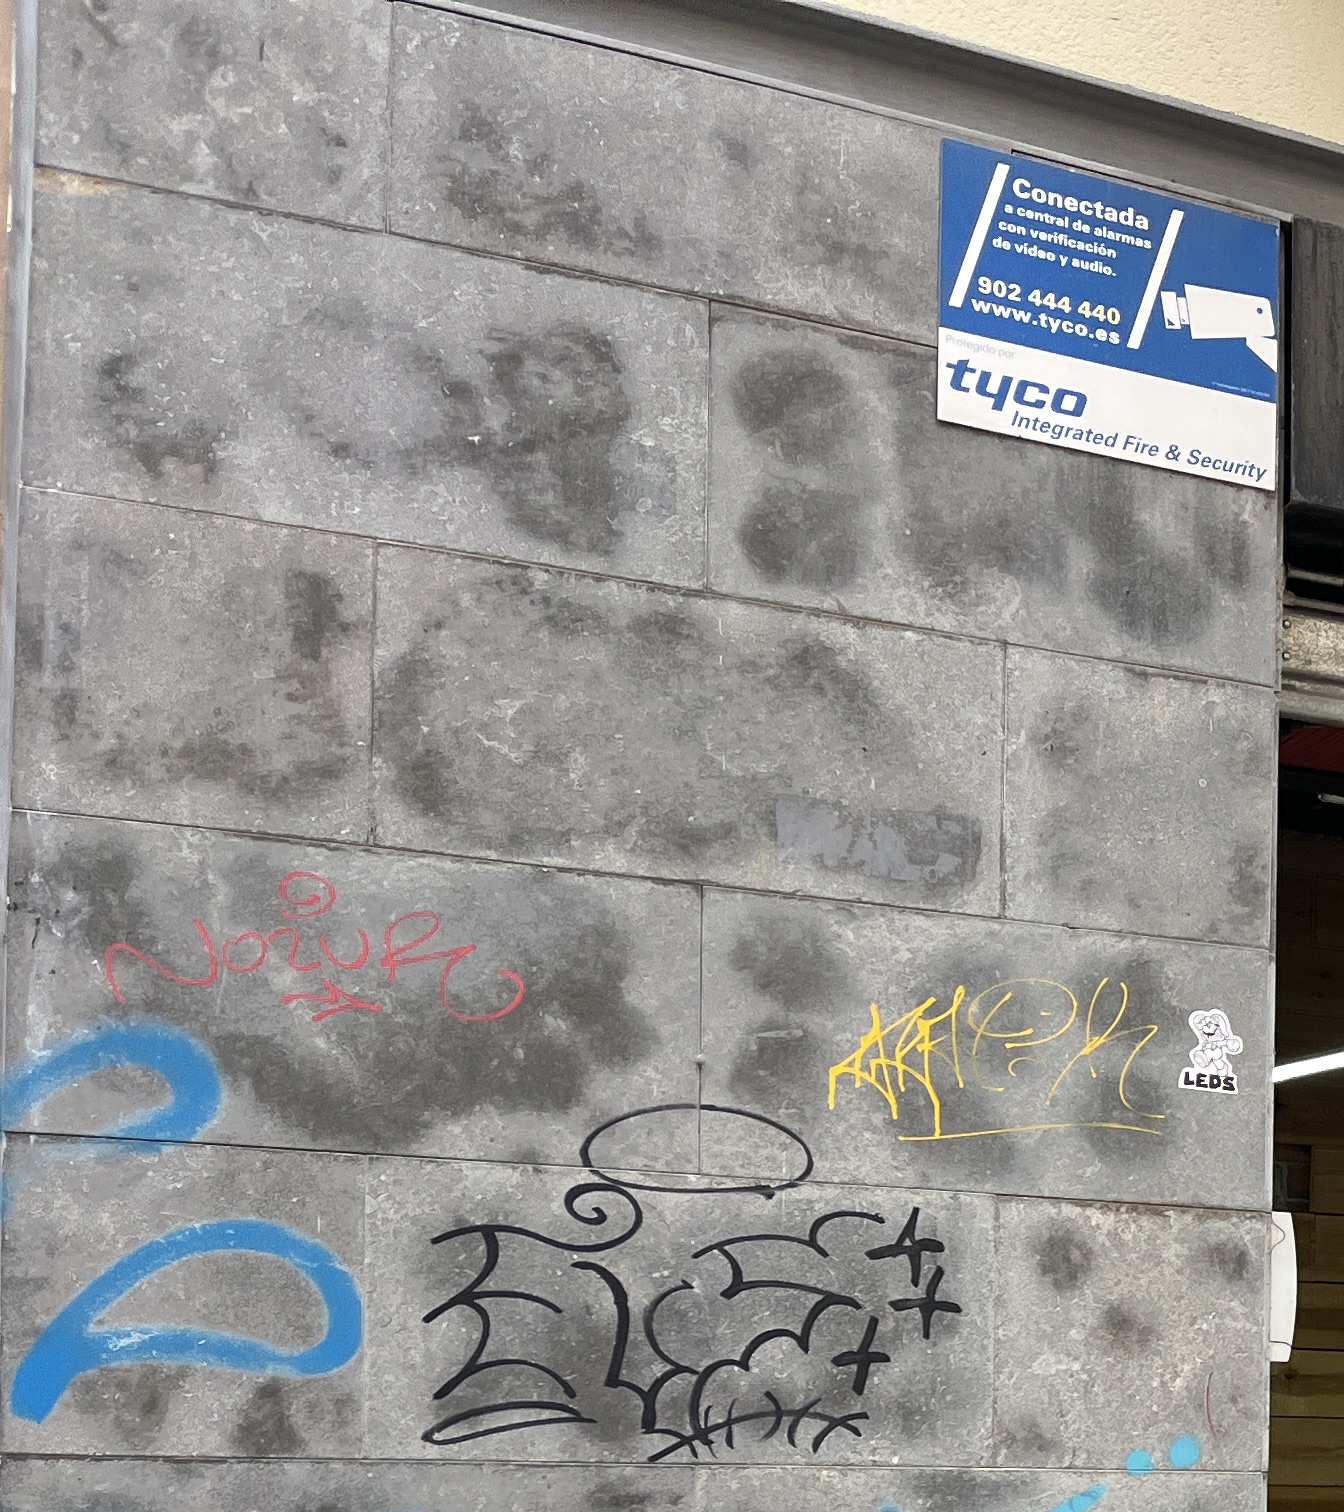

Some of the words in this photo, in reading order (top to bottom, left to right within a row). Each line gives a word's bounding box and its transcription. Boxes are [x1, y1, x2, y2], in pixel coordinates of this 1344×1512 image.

[1004, 203, 1014, 214] a
[1016, 206, 1070, 228] central
[1072, 219, 1091, 234] de
[1094, 226, 1152, 249] alarmas
[1012, 178, 1149, 231] Conectada
[992, 236, 1012, 251] de
[1059, 255, 1069, 267] y
[1071, 257, 1117, 277] audio.
[998, 221, 1026, 236] con
[1030, 228, 1117, 259] verificación
[971, 298, 1121, 345] www.tyco.es
[977, 276, 1022, 302] 902
[1027, 289, 1072, 313] 444
[1078, 301, 1121, 325] 440
[945, 334, 996, 355] Protegido
[945, 358, 1088, 418] tyco
[1011, 411, 1118, 449] Integrated
[1122, 435, 1160, 458] Fire
[1165, 444, 1180, 462] &
[1187, 449, 1268, 483] Security
[1183, 1071, 1235, 1091] LEDS
